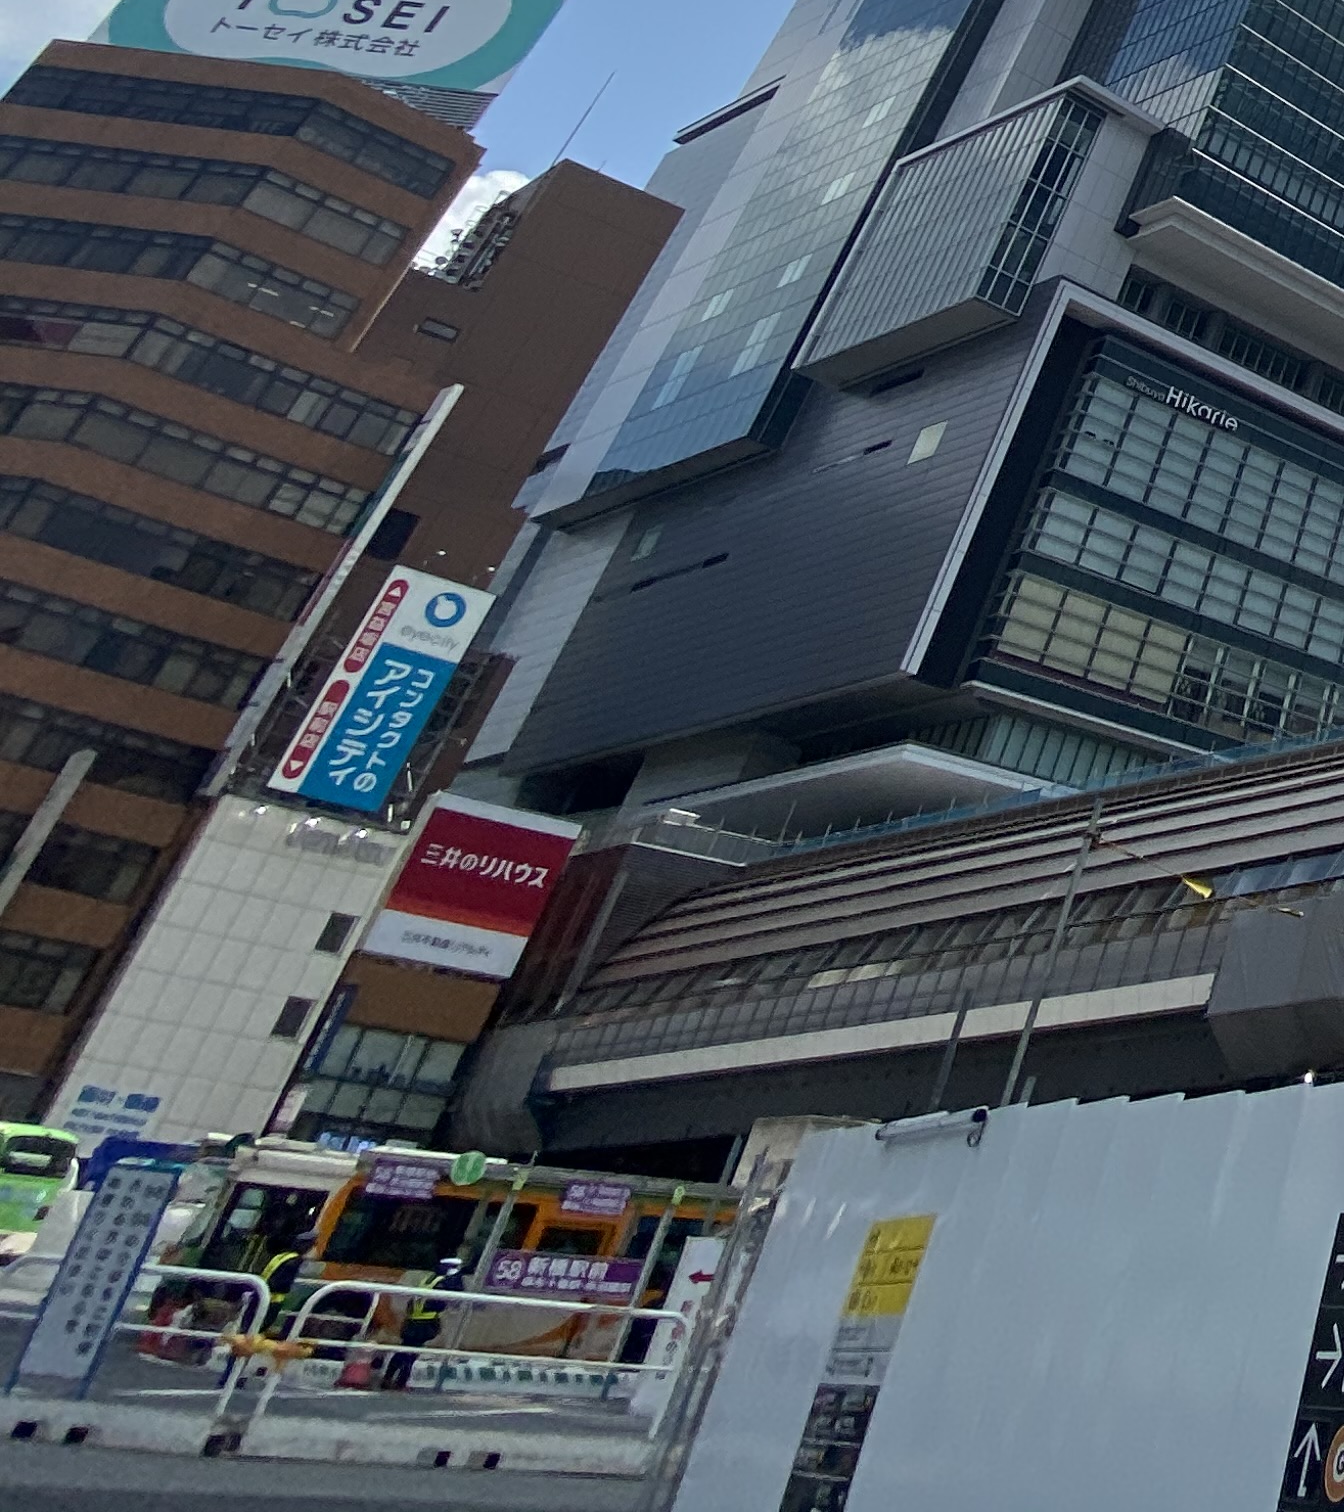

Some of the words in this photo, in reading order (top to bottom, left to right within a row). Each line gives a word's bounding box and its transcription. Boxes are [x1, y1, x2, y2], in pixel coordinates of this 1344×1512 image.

[210, 17, 420, 57] トーセイ株式会社
[1166, 386, 1239, 431] Hikarie
[328, 659, 413, 786] アイシティ
[353, 669, 436, 793] コンタクトの
[420, 843, 549, 888] 三井のリハウス
